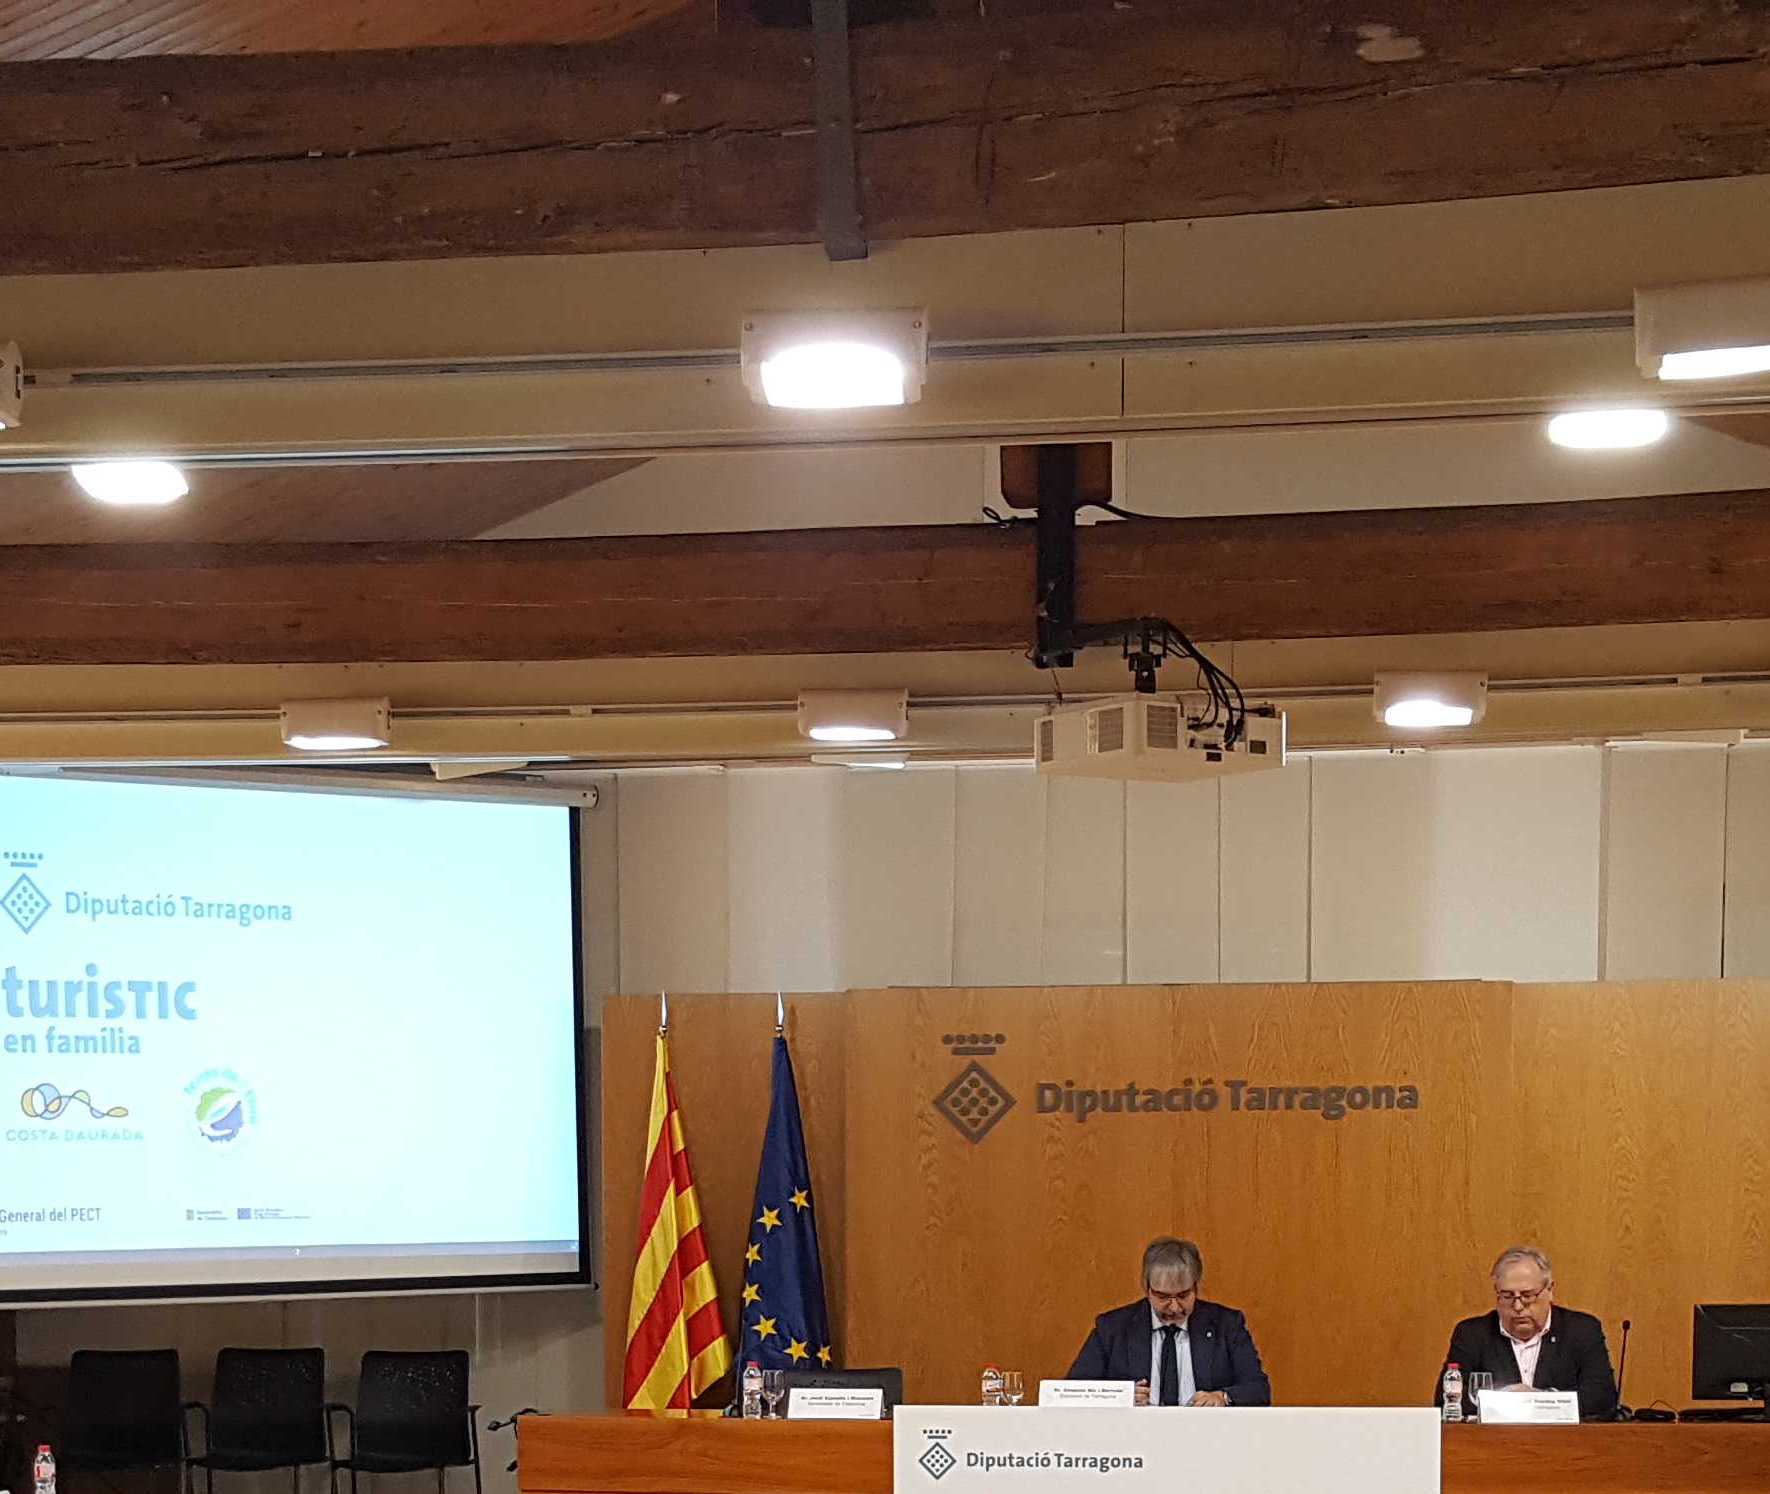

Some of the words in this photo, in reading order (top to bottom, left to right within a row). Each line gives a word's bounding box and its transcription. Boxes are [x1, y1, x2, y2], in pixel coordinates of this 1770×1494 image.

[65, 891, 176, 921] Diputació
[181, 896, 292, 927] Tarragona
[3, 1033, 36, 1053] en
[46, 1026, 141, 1054] família
[1036, 1078, 1218, 1123] Diputació
[1225, 1079, 1420, 1120] Tarragona
[6, 1129, 59, 1142] COSTA
[65, 1129, 144, 1142] DAURADA
[49, 1207, 67, 1222] del
[70, 1207, 101, 1222] PECT
[967, 1452, 1052, 1471] Diputació
[1054, 1453, 1144, 1473] Tarragona
